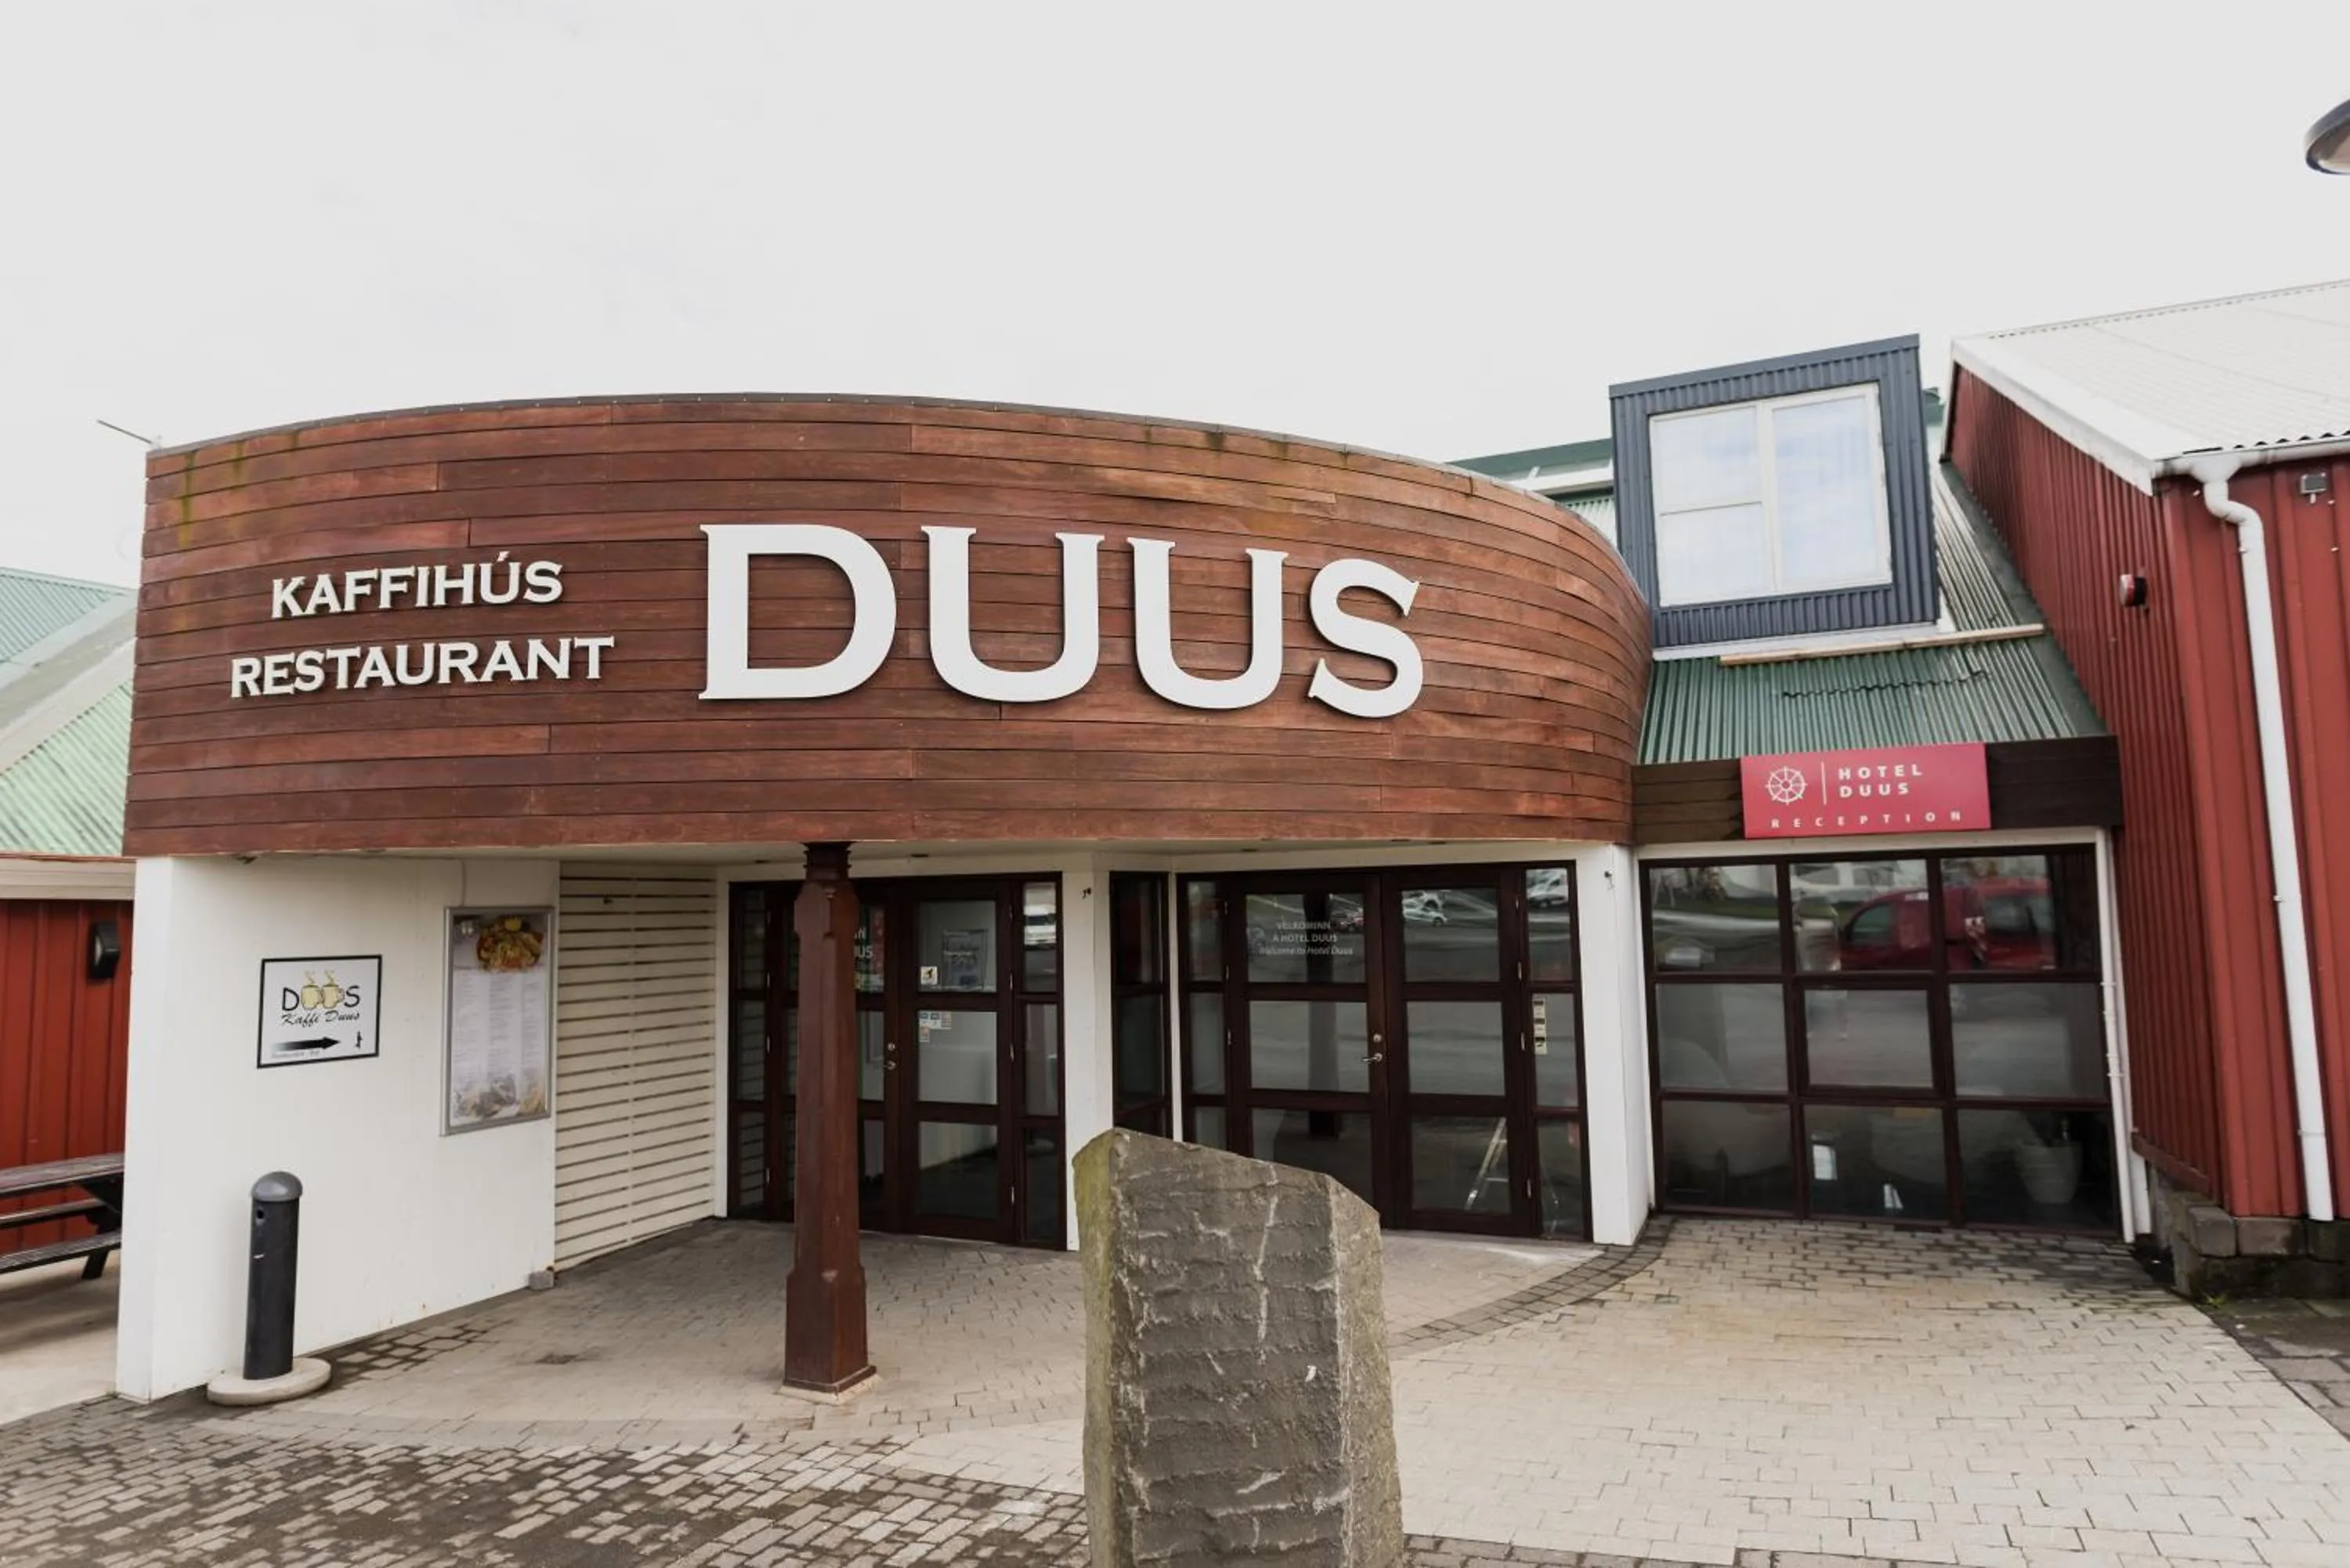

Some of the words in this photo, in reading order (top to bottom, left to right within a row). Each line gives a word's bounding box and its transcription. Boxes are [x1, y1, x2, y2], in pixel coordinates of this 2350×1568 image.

[270, 551, 563, 619] KAFFIHÚS
[698, 523, 1425, 718] DUUS
[230, 635, 615, 698] RESTAURANT
[1838, 764, 1922, 781] HOTEL
[1839, 782, 1910, 798] DUUS
[1771, 811, 1961, 828] RECEPTION
